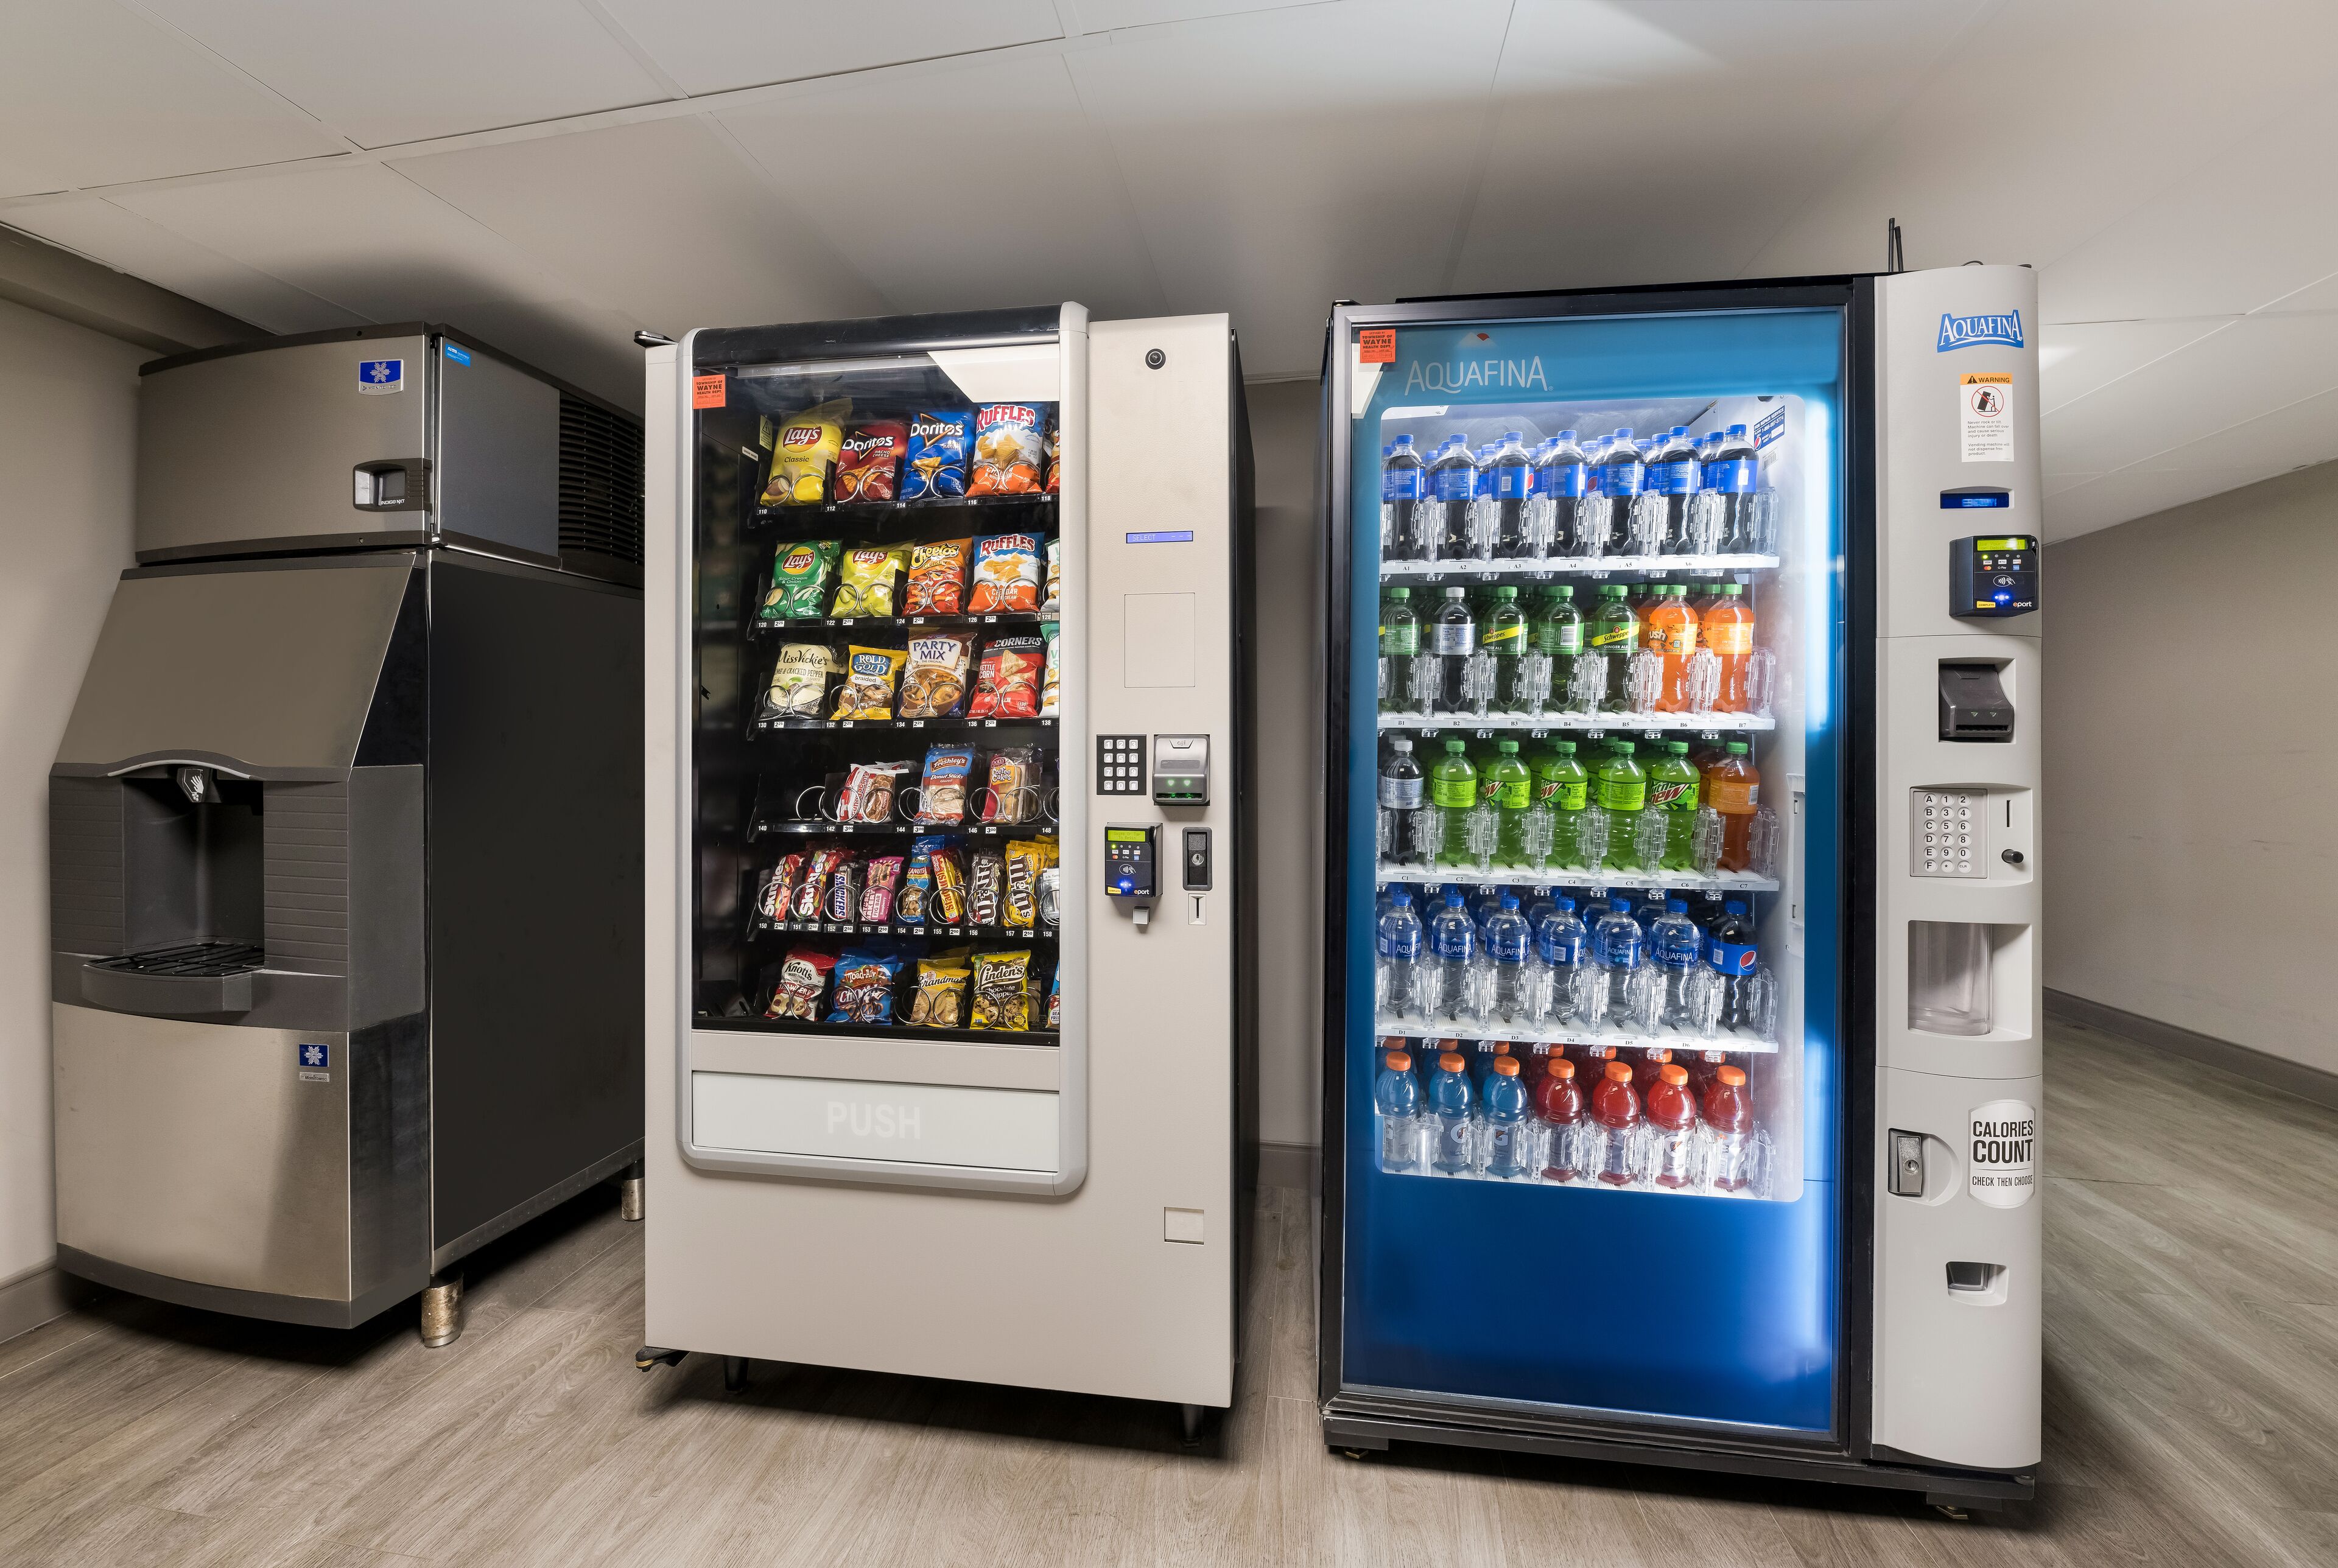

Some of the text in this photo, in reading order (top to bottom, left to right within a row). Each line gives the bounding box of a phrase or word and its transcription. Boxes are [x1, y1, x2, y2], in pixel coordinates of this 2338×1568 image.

[1939, 312, 2021, 346] AQUAFINA
[1404, 355, 1548, 396] AQUAFINA
[977, 405, 1035, 432] RUFFLES
[1760, 416, 1771, 426] REPAIR
[1771, 407, 1785, 419] SERVICE
[911, 422, 963, 436] Doritos
[784, 427, 821, 446] Lay's
[841, 436, 894, 451] Doritos
[1132, 533, 1156, 542] SELECT
[980, 534, 1035, 558] RUFFLES
[784, 552, 813, 569] Lay's
[854, 550, 886, 564] Lay's
[911, 543, 961, 569] Cheetos
[1484, 632, 1506, 643] Schweppes
[913, 640, 957, 652] PARTY
[858, 654, 886, 664] ROLD
[920, 651, 946, 661] MIX
[786, 667, 824, 679] CRACKED PEPPER
[854, 663, 887, 674] GOLD
[979, 670, 995, 679] CORN
[933, 758, 966, 768] Freshley's
[992, 767, 1011, 775] Coffee
[992, 774, 1011, 782] Cakes
[835, 874, 846, 918] SNICKERS
[1438, 942, 1473, 956] AQUAFINA
[1492, 943, 1526, 956] AQUAFINA
[1655, 948, 1694, 962] AQUAFINA
[784, 962, 812, 981] Knott's
[978, 964, 1024, 985] Linden's
[827, 1101, 921, 1139] PUSH
[1973, 1120, 2033, 1138] CALORIES
[1973, 1139, 2033, 1163] COUNT
[1973, 1175, 2032, 1187] CHECK THEN CHOOSE
